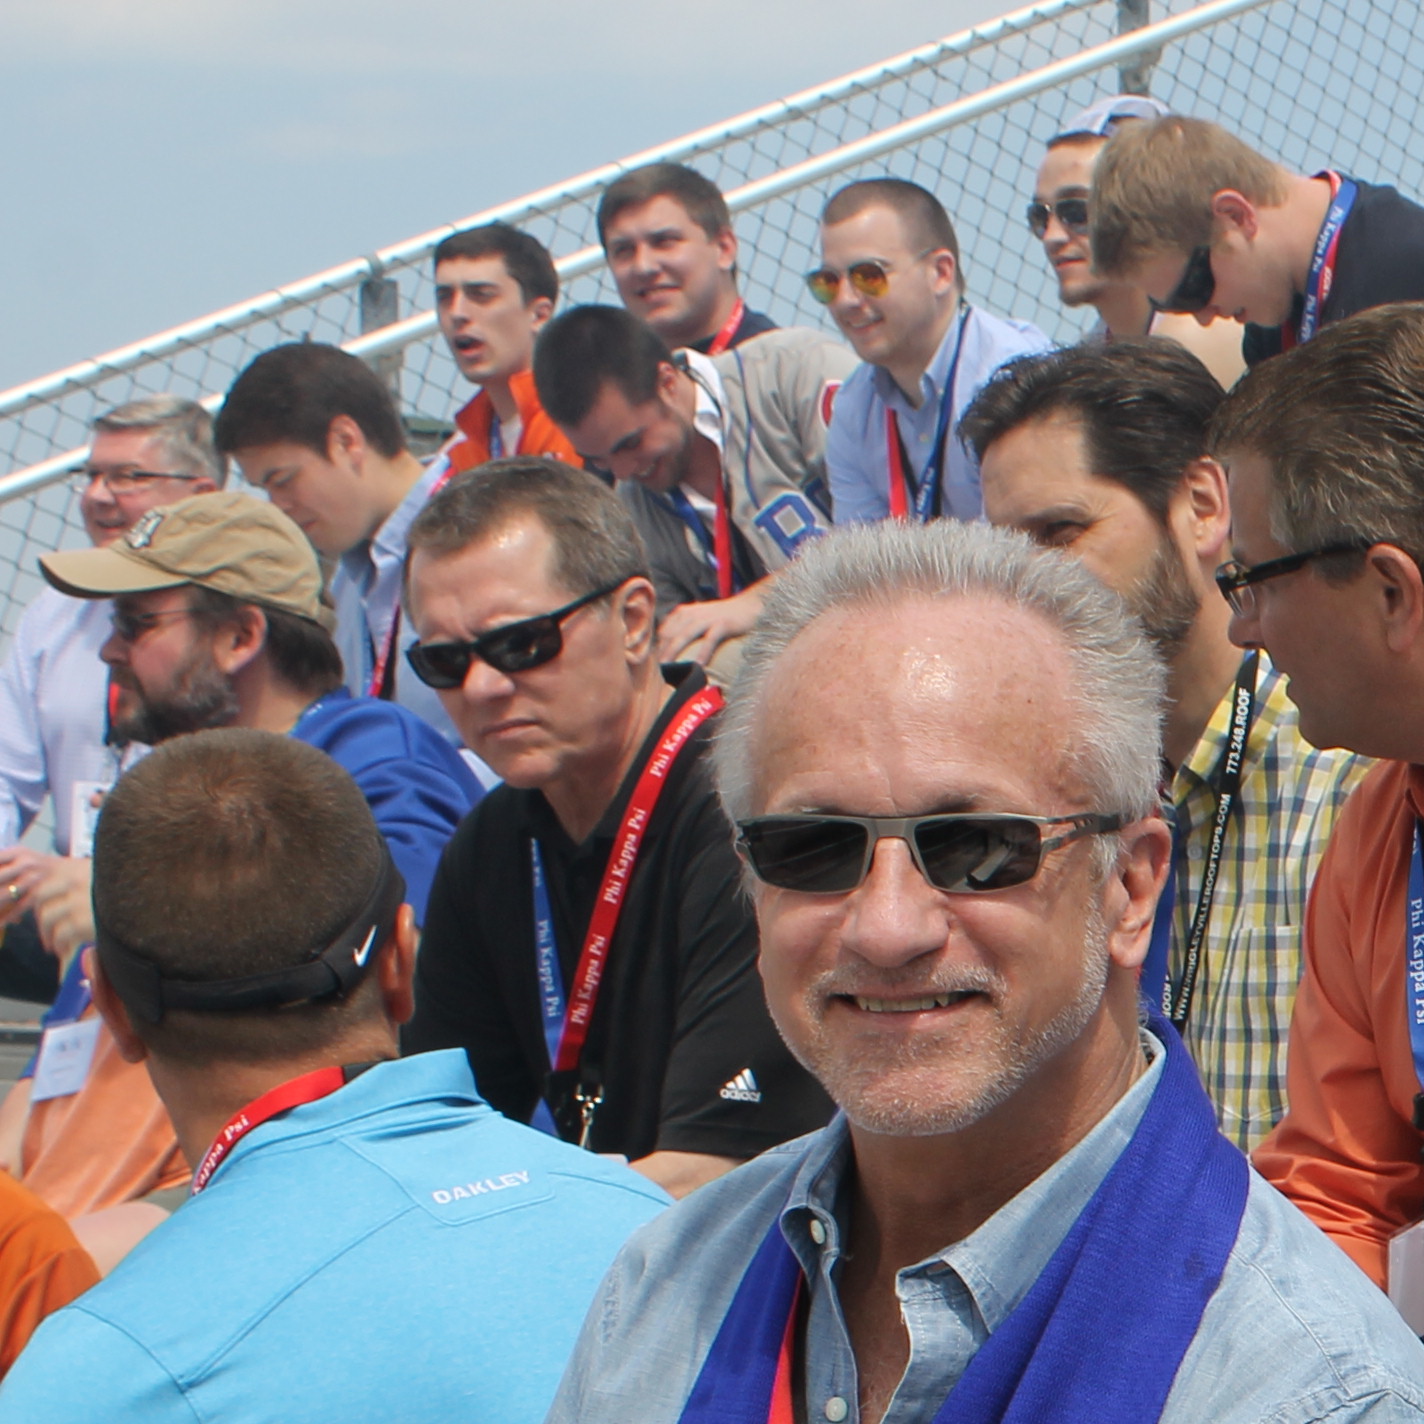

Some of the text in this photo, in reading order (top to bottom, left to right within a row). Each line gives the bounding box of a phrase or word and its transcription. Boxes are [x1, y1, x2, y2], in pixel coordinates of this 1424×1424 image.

[650, 699, 712, 778] Phi Kappa Psi
[1225, 687, 1251, 776] 773.248.ROOF
[604, 808, 647, 905] Phi Kappa Psi
[571, 934, 606, 1025] Phi Kappa Psi
[223, 1115, 250, 1141] Psi
[432, 1171, 532, 1205] OAKLEY
